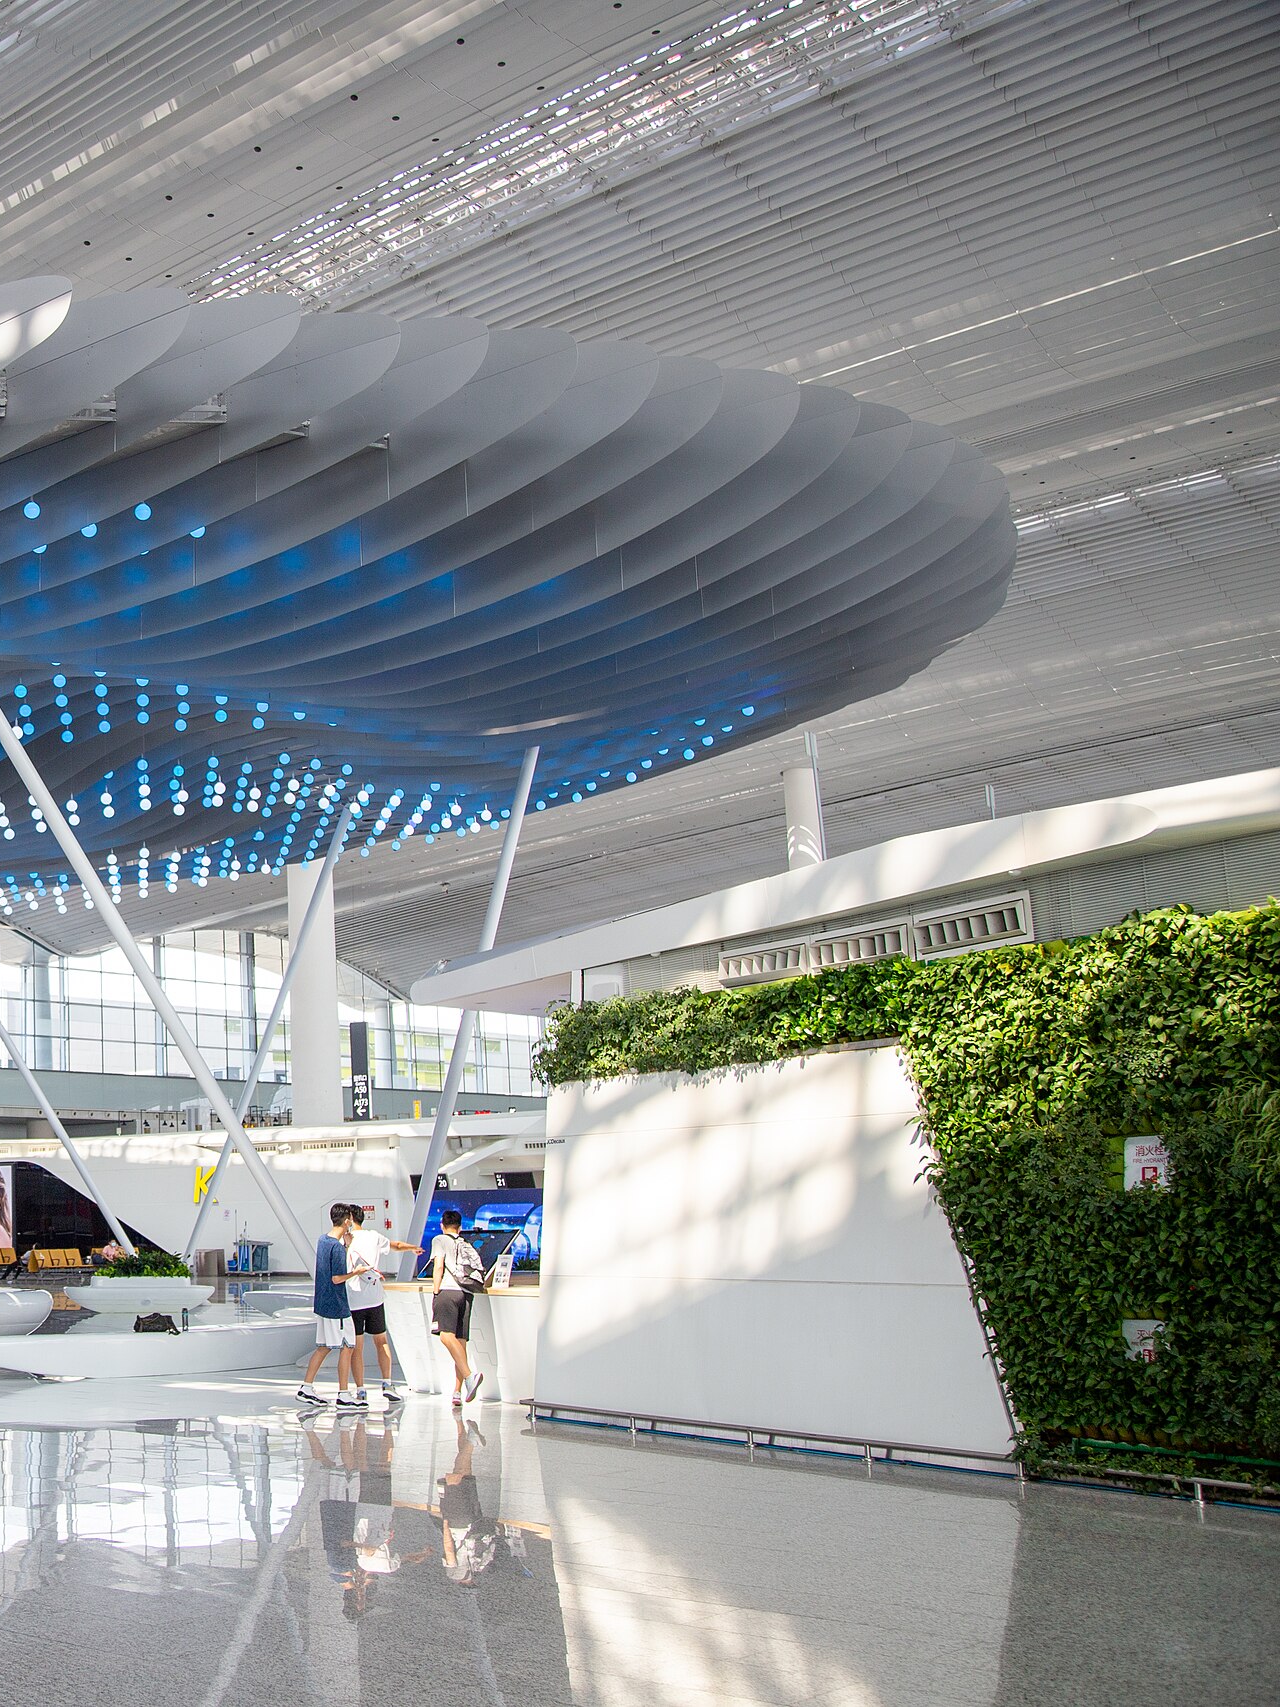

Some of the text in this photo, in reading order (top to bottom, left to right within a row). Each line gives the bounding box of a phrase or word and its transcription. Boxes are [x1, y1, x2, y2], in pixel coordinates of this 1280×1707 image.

[354, 1098, 368, 1106] A173
[1135, 1145, 1164, 1156] 消火栓
[194, 1166, 219, 1203] K
[438, 1180, 447, 1188] 20
